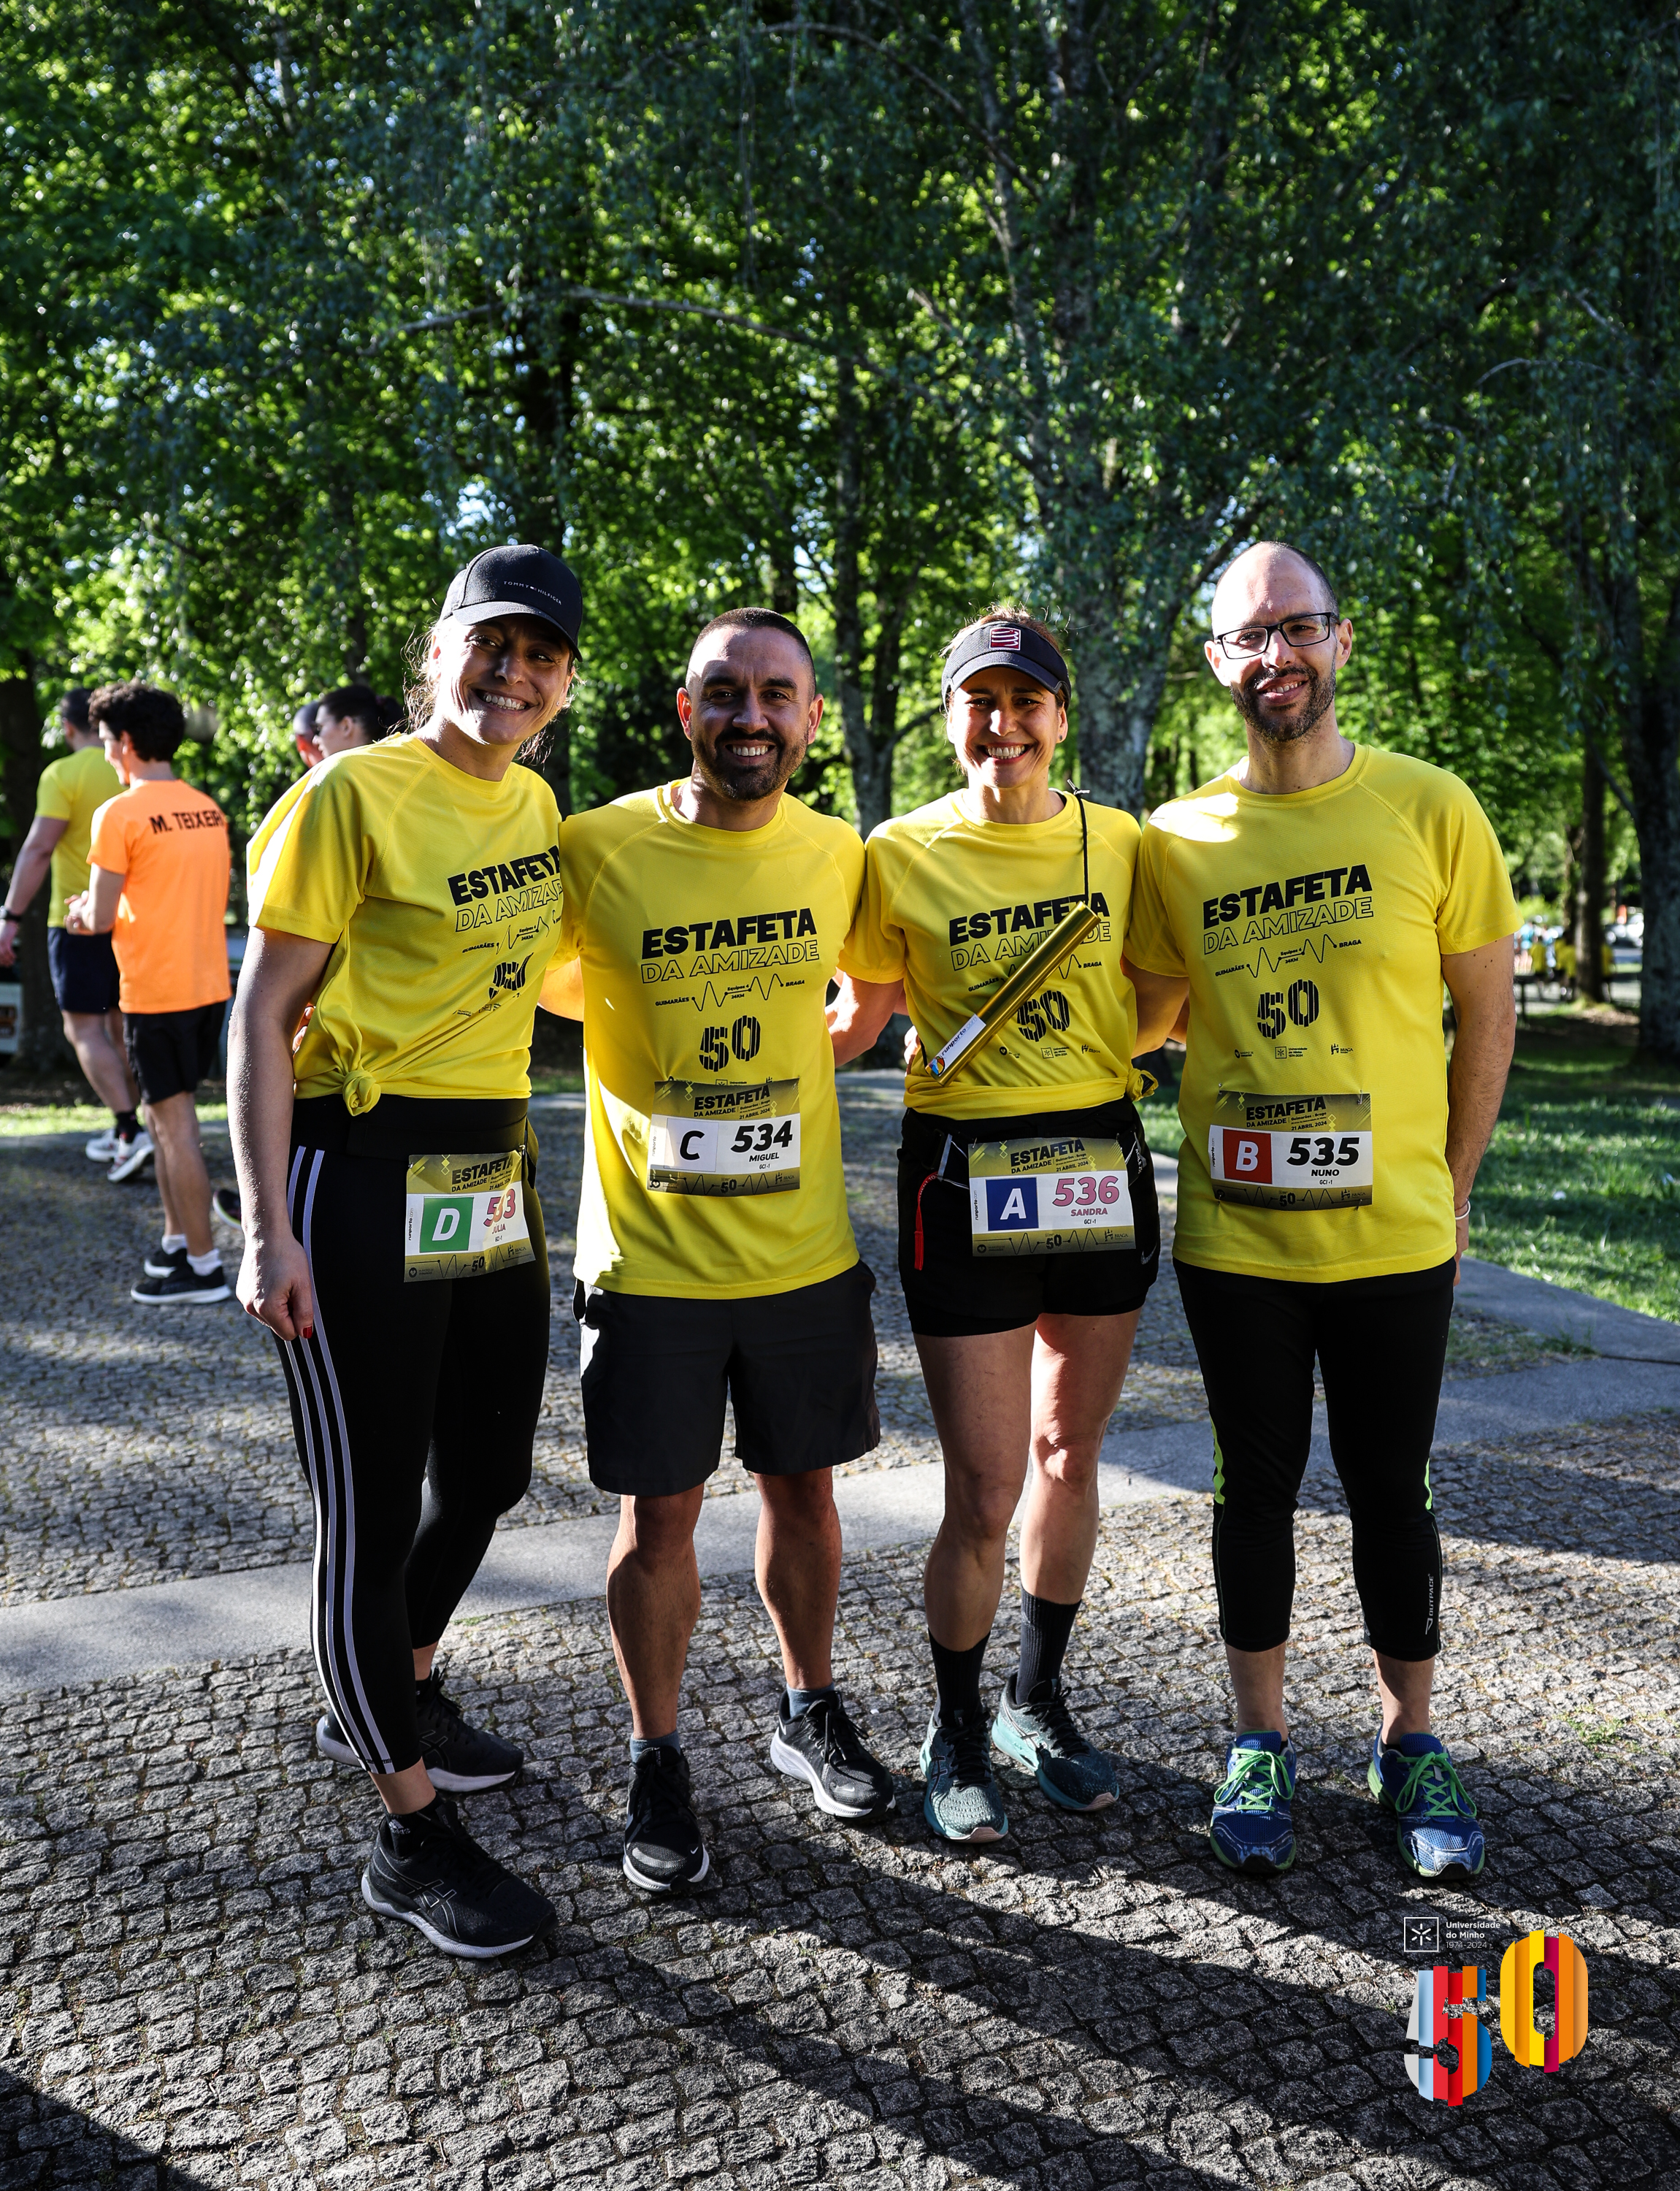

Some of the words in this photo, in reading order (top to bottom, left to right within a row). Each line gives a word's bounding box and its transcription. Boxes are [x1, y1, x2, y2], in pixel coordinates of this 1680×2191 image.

[503, 581, 529, 589] TOMMY
[537, 589, 562, 605] HILFIGER
[148, 814, 174, 835] M.
[447, 844, 561, 907] ESTAFETA
[1203, 863, 1373, 930] ESTAFETA
[454, 904, 493, 933] DA
[1203, 925, 1239, 956] DA
[1242, 895, 1374, 944] AMIZADE
[641, 907, 818, 960] ESTAFETA
[951, 942, 991, 971] DA
[994, 920, 1112, 961] AMIDE
[1338, 939, 1362, 949] BRAGA
[640, 958, 685, 984] DA
[689, 938, 820, 978] AMIZADE
[1083, 960, 1102, 968] BRAGA
[1215, 964, 1245, 977] GUIMARÃES
[785, 979, 805, 987] BRAGA
[655, 996, 690, 1007] GUIMARÃES
[1257, 979, 1319, 1040] 50
[1016, 990, 1070, 1043] 50
[699, 1014, 761, 1072] 50
[694, 1085, 771, 1111] ESTAFETA
[1246, 1096, 1327, 1121] ESTAFETA
[704, 1107, 736, 1117] AMIZADE
[1256, 1117, 1287, 1127] AMIZADE
[679, 1130, 705, 1161] C
[729, 1120, 794, 1153] 534
[748, 1152, 780, 1163] MIGUEL
[1010, 1139, 1086, 1168] ESTAFETA
[1235, 1140, 1259, 1171] B
[1286, 1136, 1360, 1167] 535
[451, 1155, 513, 1185] ESTAFETA
[1021, 1159, 1052, 1172] AMIZADE
[1062, 1163, 1077, 1171] ABRIL
[1310, 1169, 1340, 1177] NUNO
[451, 1185, 461, 1193] DA
[461, 1177, 488, 1190] AMIZADE
[720, 1179, 737, 1194] 50
[1051, 1175, 1120, 1207] 536
[1000, 1188, 1027, 1220] A
[1070, 1207, 1108, 1217] SANDRA
[1278, 1192, 1296, 1207] 50
[431, 1207, 461, 1242] D
[1046, 1234, 1062, 1250] 50
